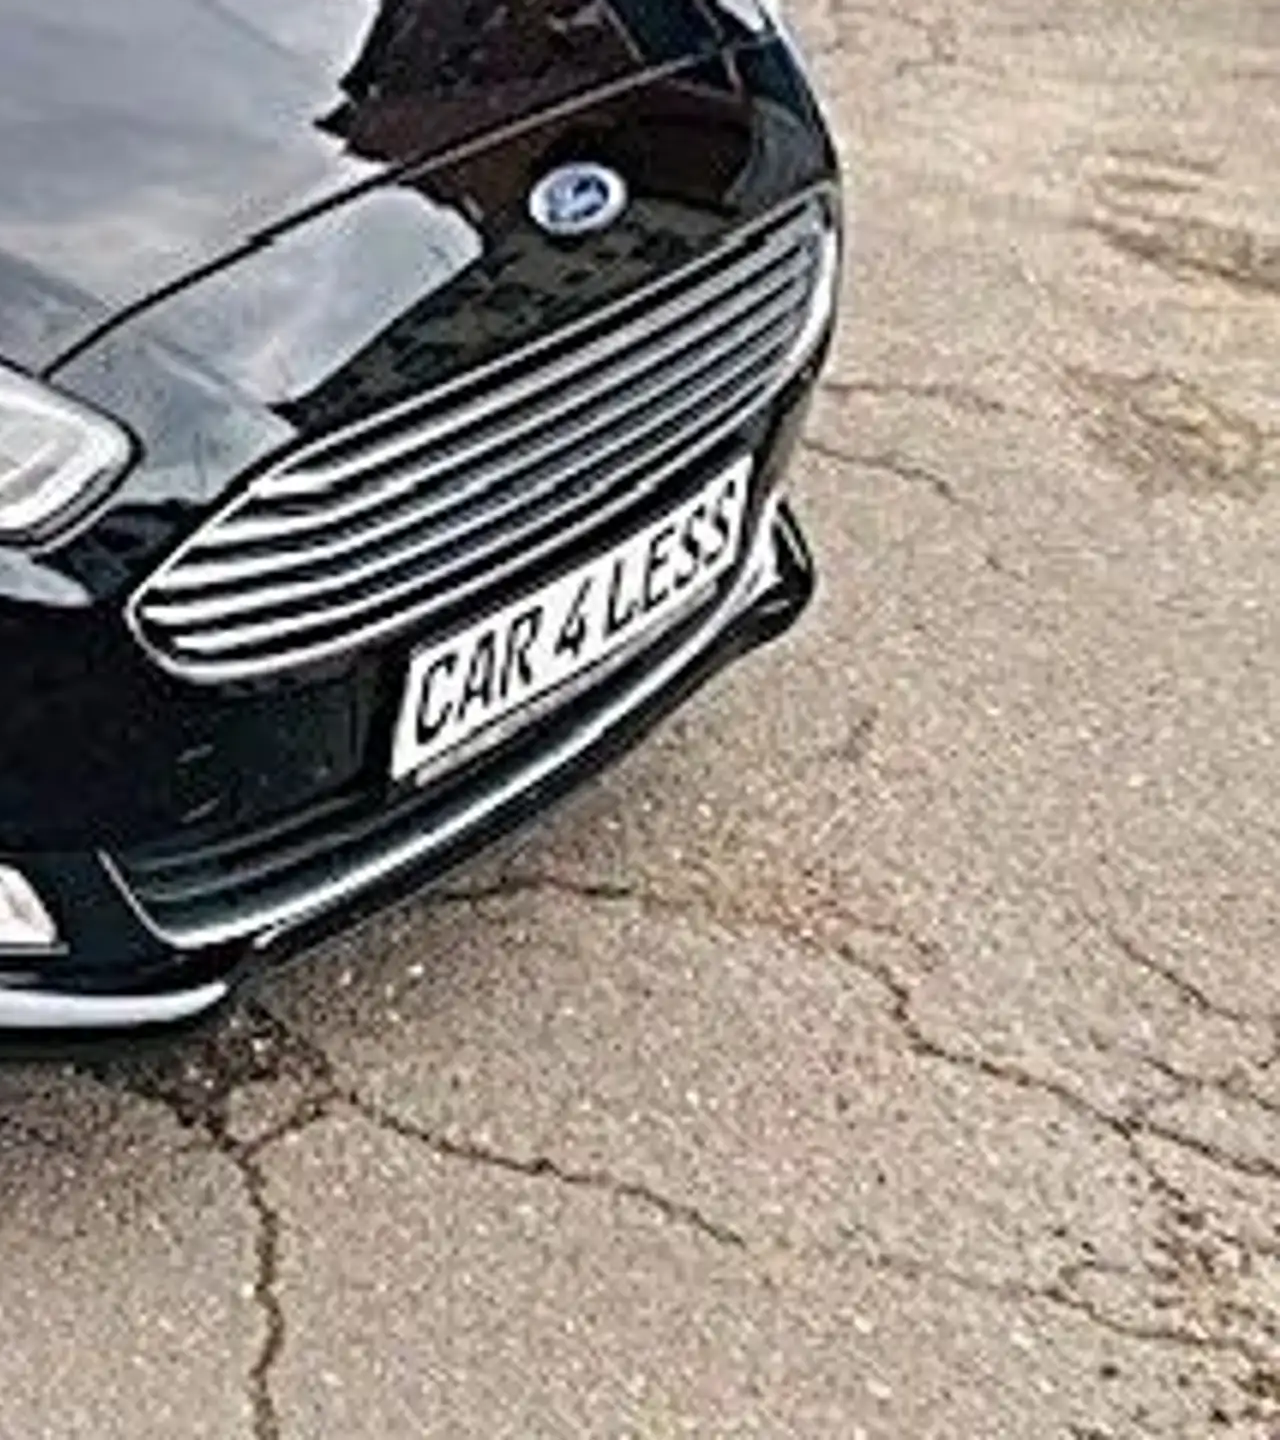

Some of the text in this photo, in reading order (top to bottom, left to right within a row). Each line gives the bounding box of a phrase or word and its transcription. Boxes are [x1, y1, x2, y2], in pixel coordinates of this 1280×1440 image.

[415, 479, 738, 745] CAR 4 LESS
